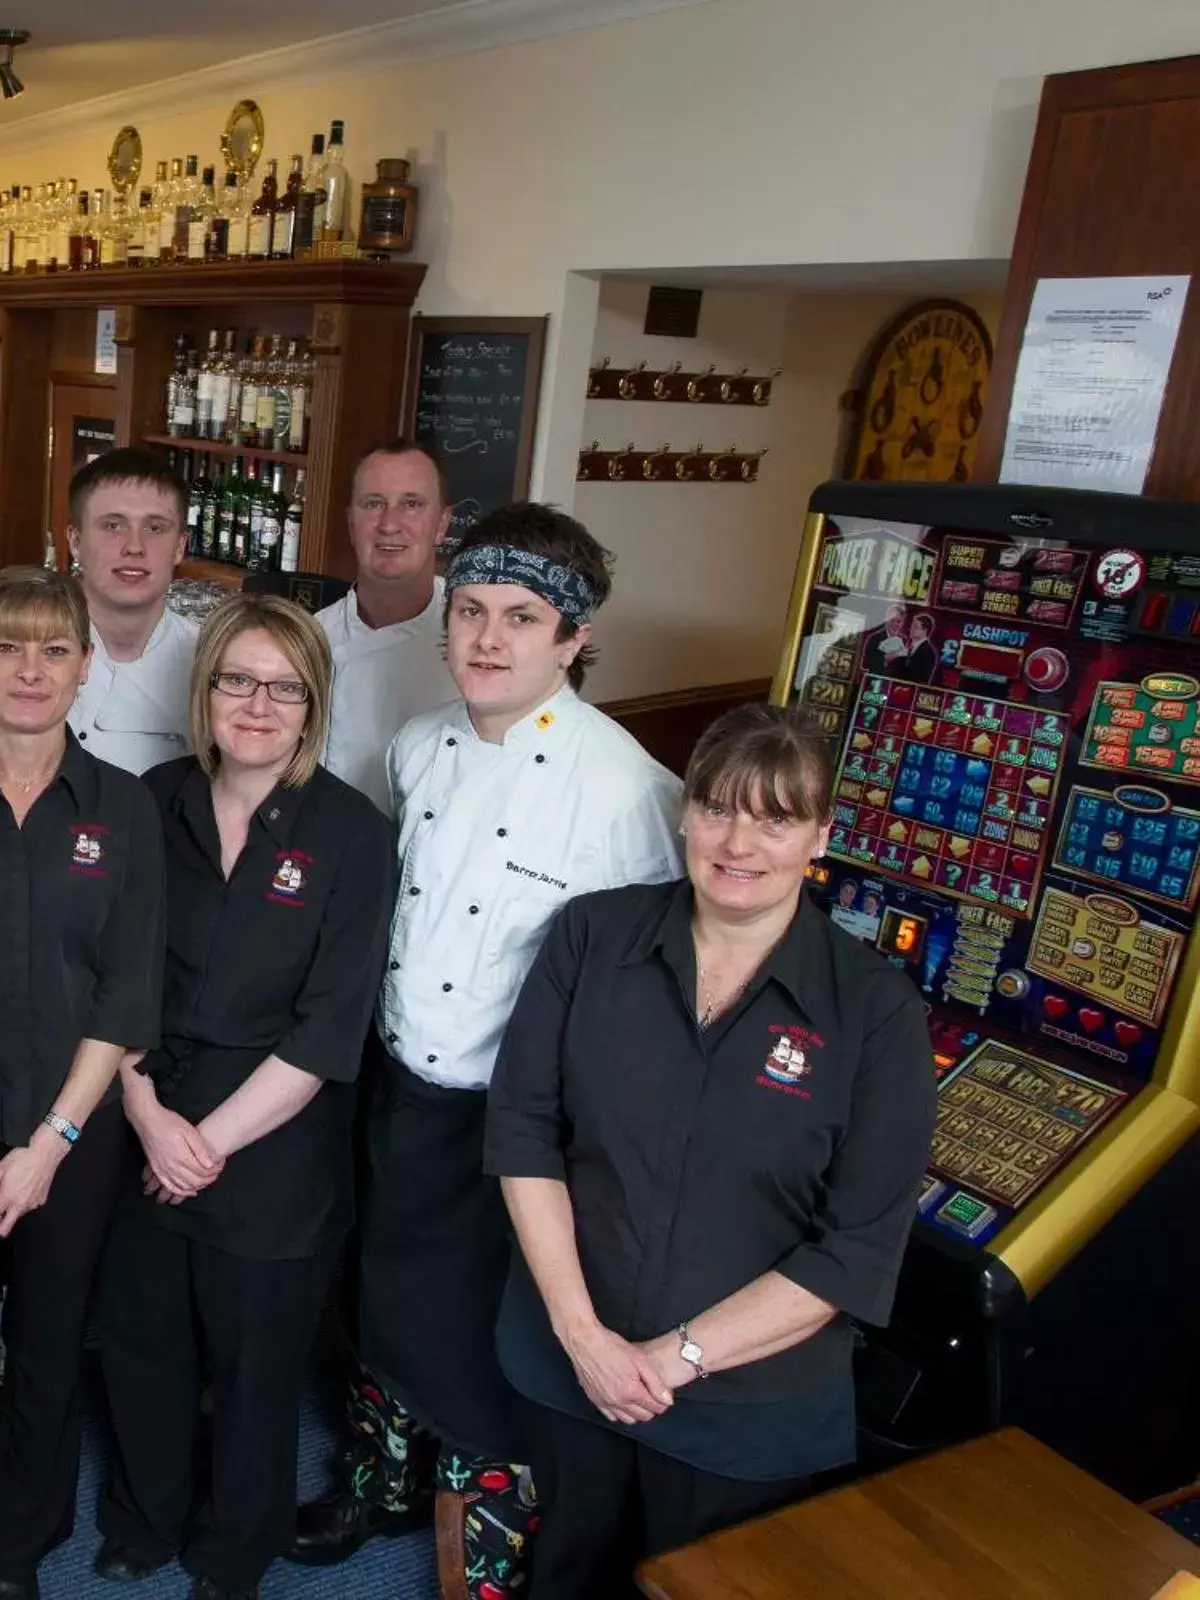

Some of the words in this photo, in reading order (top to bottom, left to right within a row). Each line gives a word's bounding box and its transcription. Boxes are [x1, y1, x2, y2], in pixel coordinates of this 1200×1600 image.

[877, 539, 936, 600] FACE
[962, 622, 1032, 647] CASHPOT
[895, 917, 918, 951] 5
